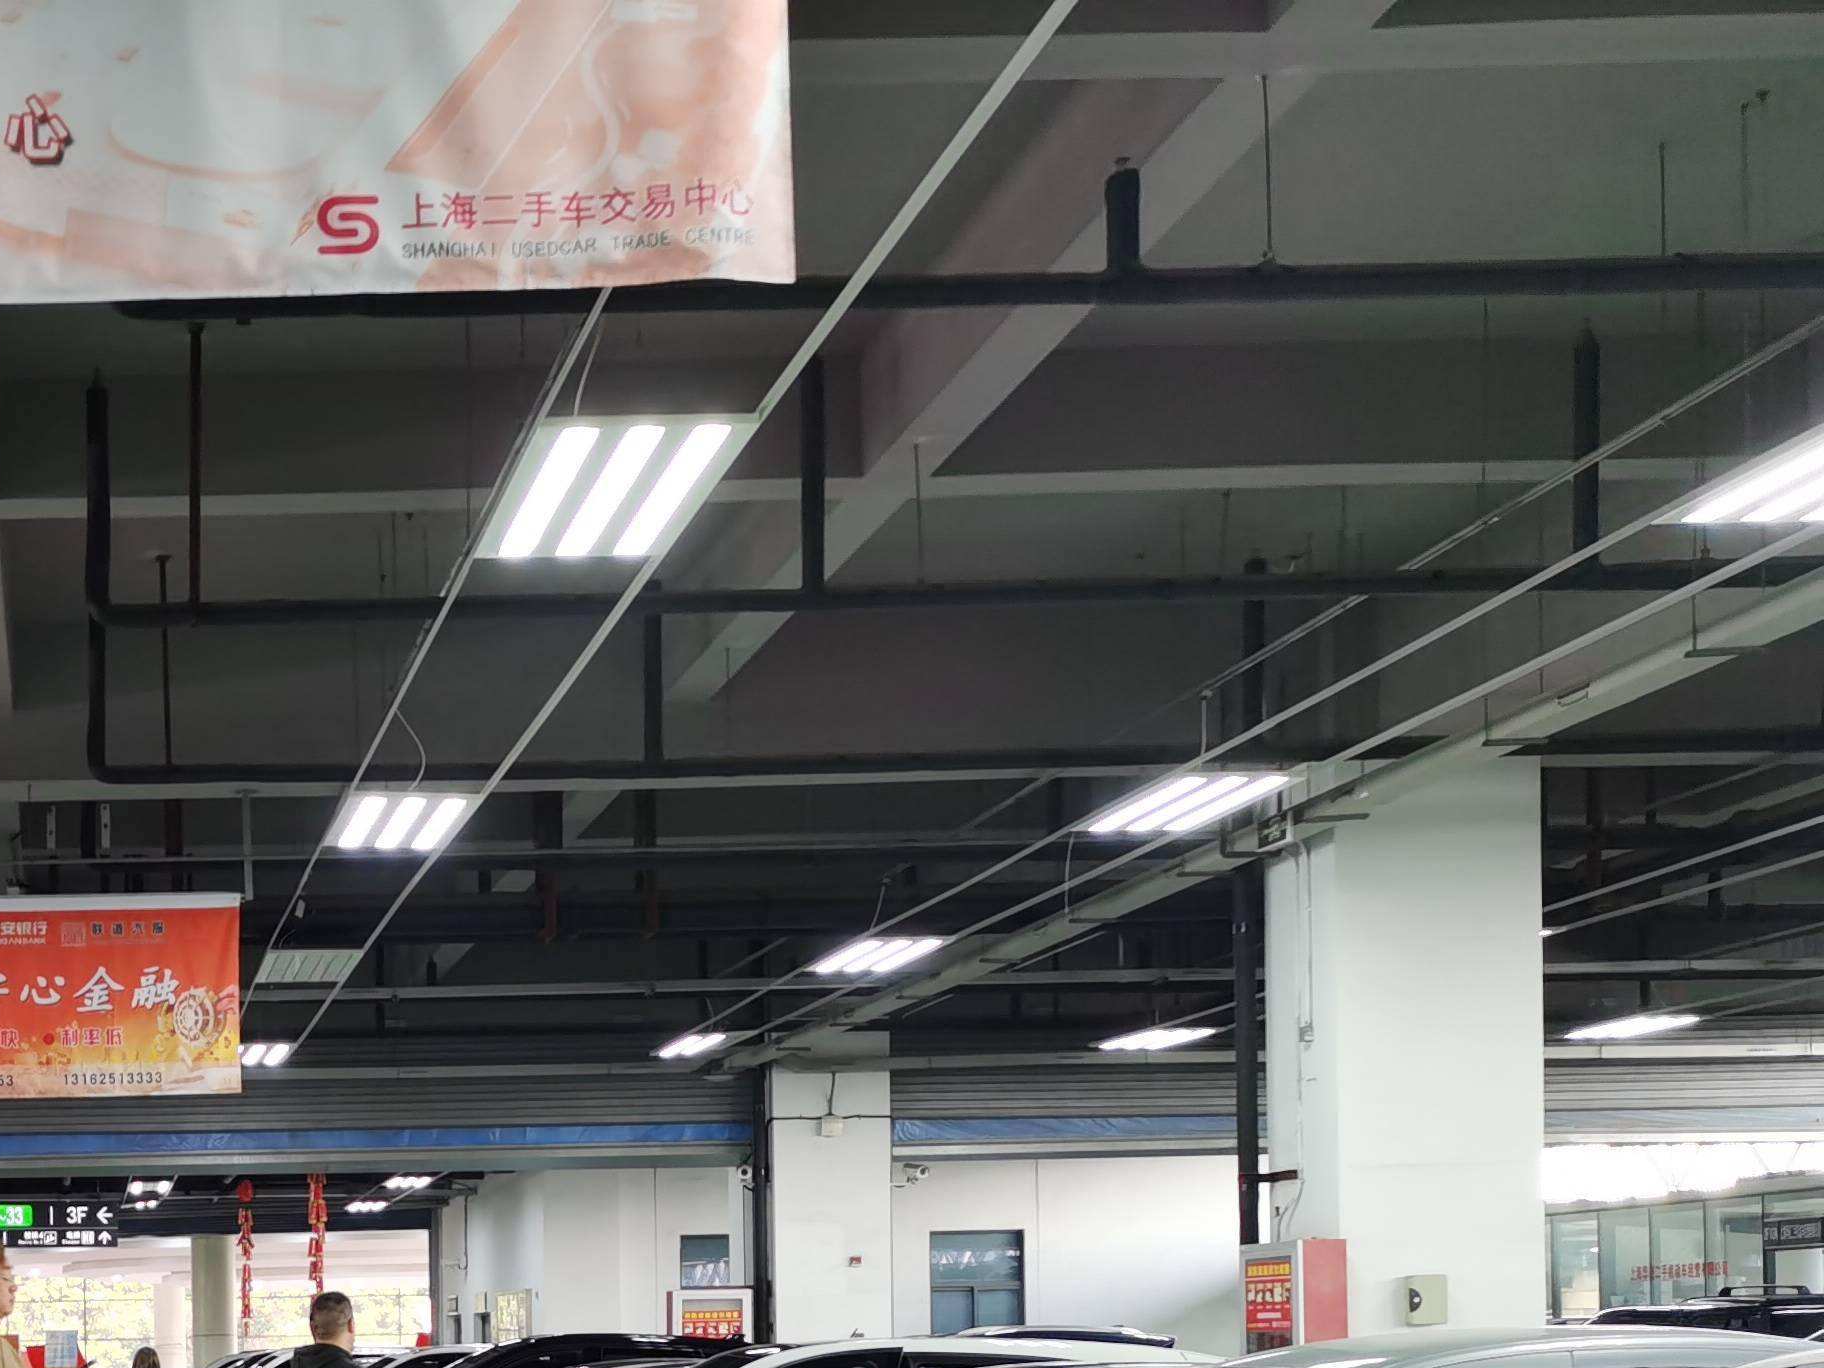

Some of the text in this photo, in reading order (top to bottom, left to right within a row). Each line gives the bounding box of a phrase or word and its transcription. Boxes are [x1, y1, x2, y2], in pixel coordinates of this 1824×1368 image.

[401, 177, 755, 229] 上海二手车交易中心
[402, 241, 496, 259] SHANGHAI
[612, 228, 672, 251] TRADE
[684, 224, 756, 246] CENTRE
[60, 1024, 125, 1048] 利率低
[63, 1071, 164, 1087] 13162513333
[66, 1206, 88, 1225] 3F
